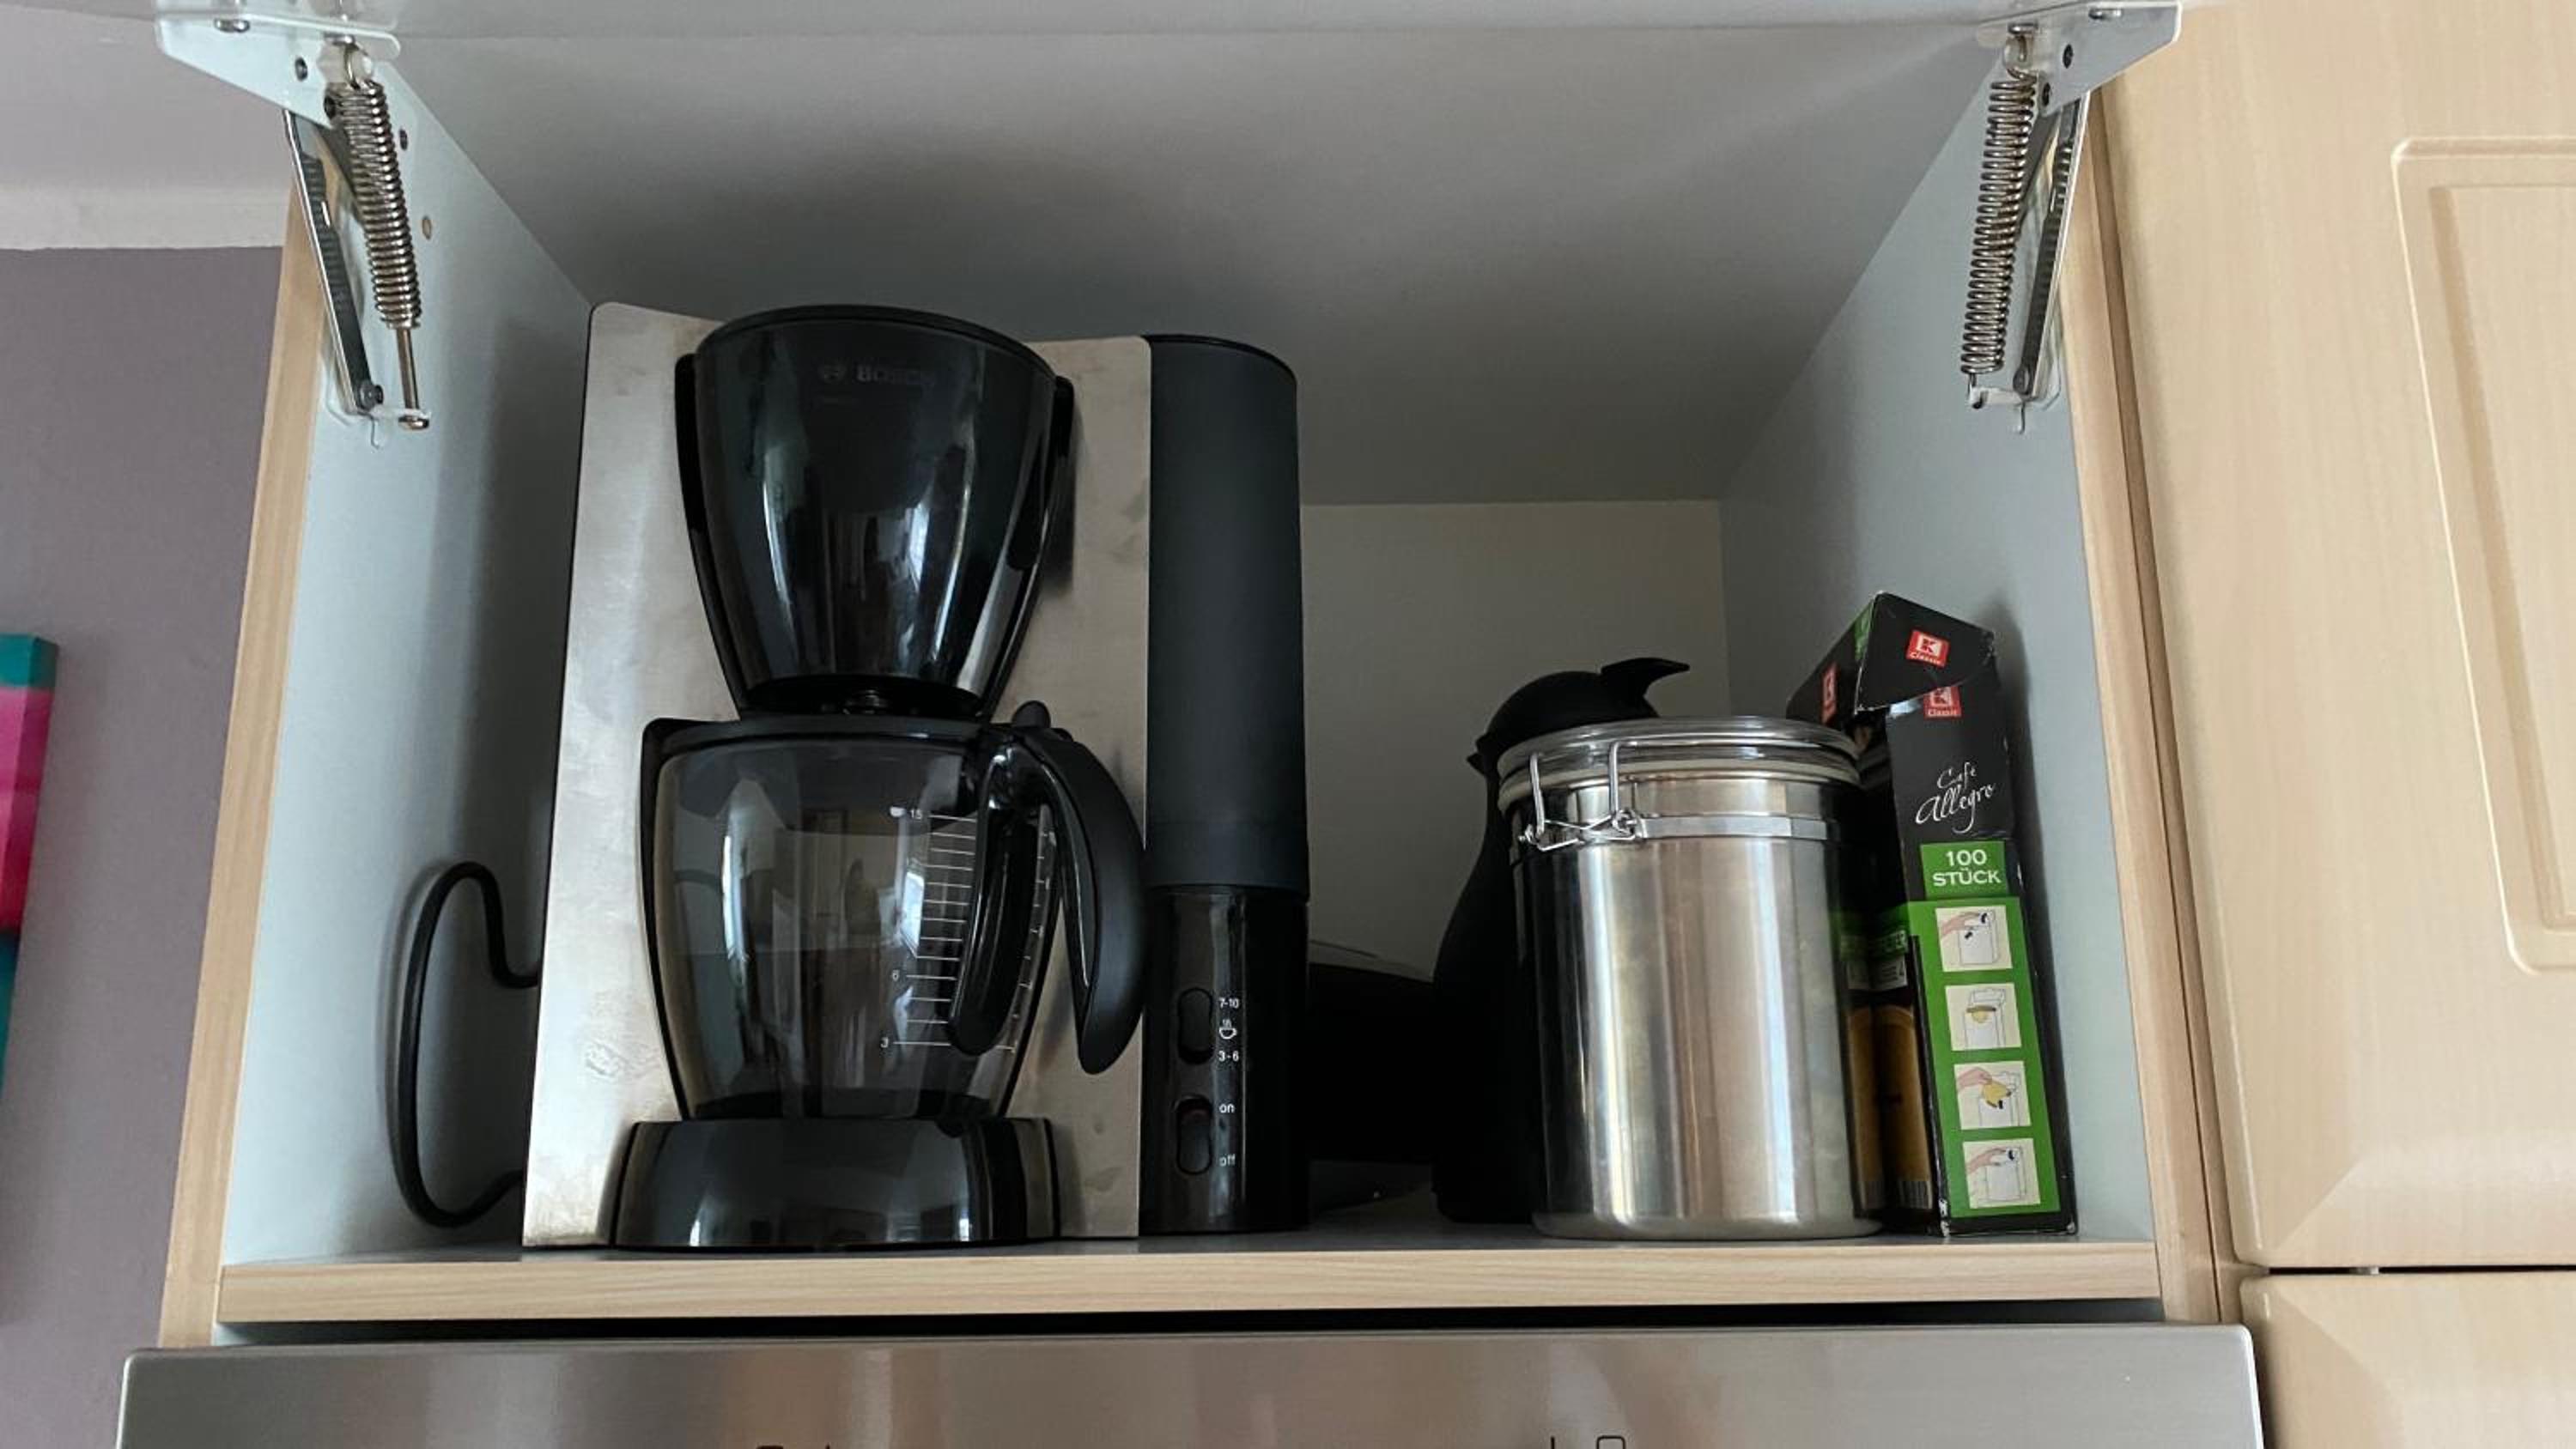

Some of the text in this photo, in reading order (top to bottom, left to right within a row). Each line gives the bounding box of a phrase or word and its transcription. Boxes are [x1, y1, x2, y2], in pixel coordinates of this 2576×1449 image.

[1928, 707, 1958, 717] Classic
[1915, 783, 1996, 834] Allegro
[1946, 849, 1988, 867] 100
[1932, 867, 2002, 887] STÜCK
[1218, 997, 1240, 1009] 7-10
[1218, 1103, 1236, 1113] on
[1218, 1153, 1236, 1167] off
